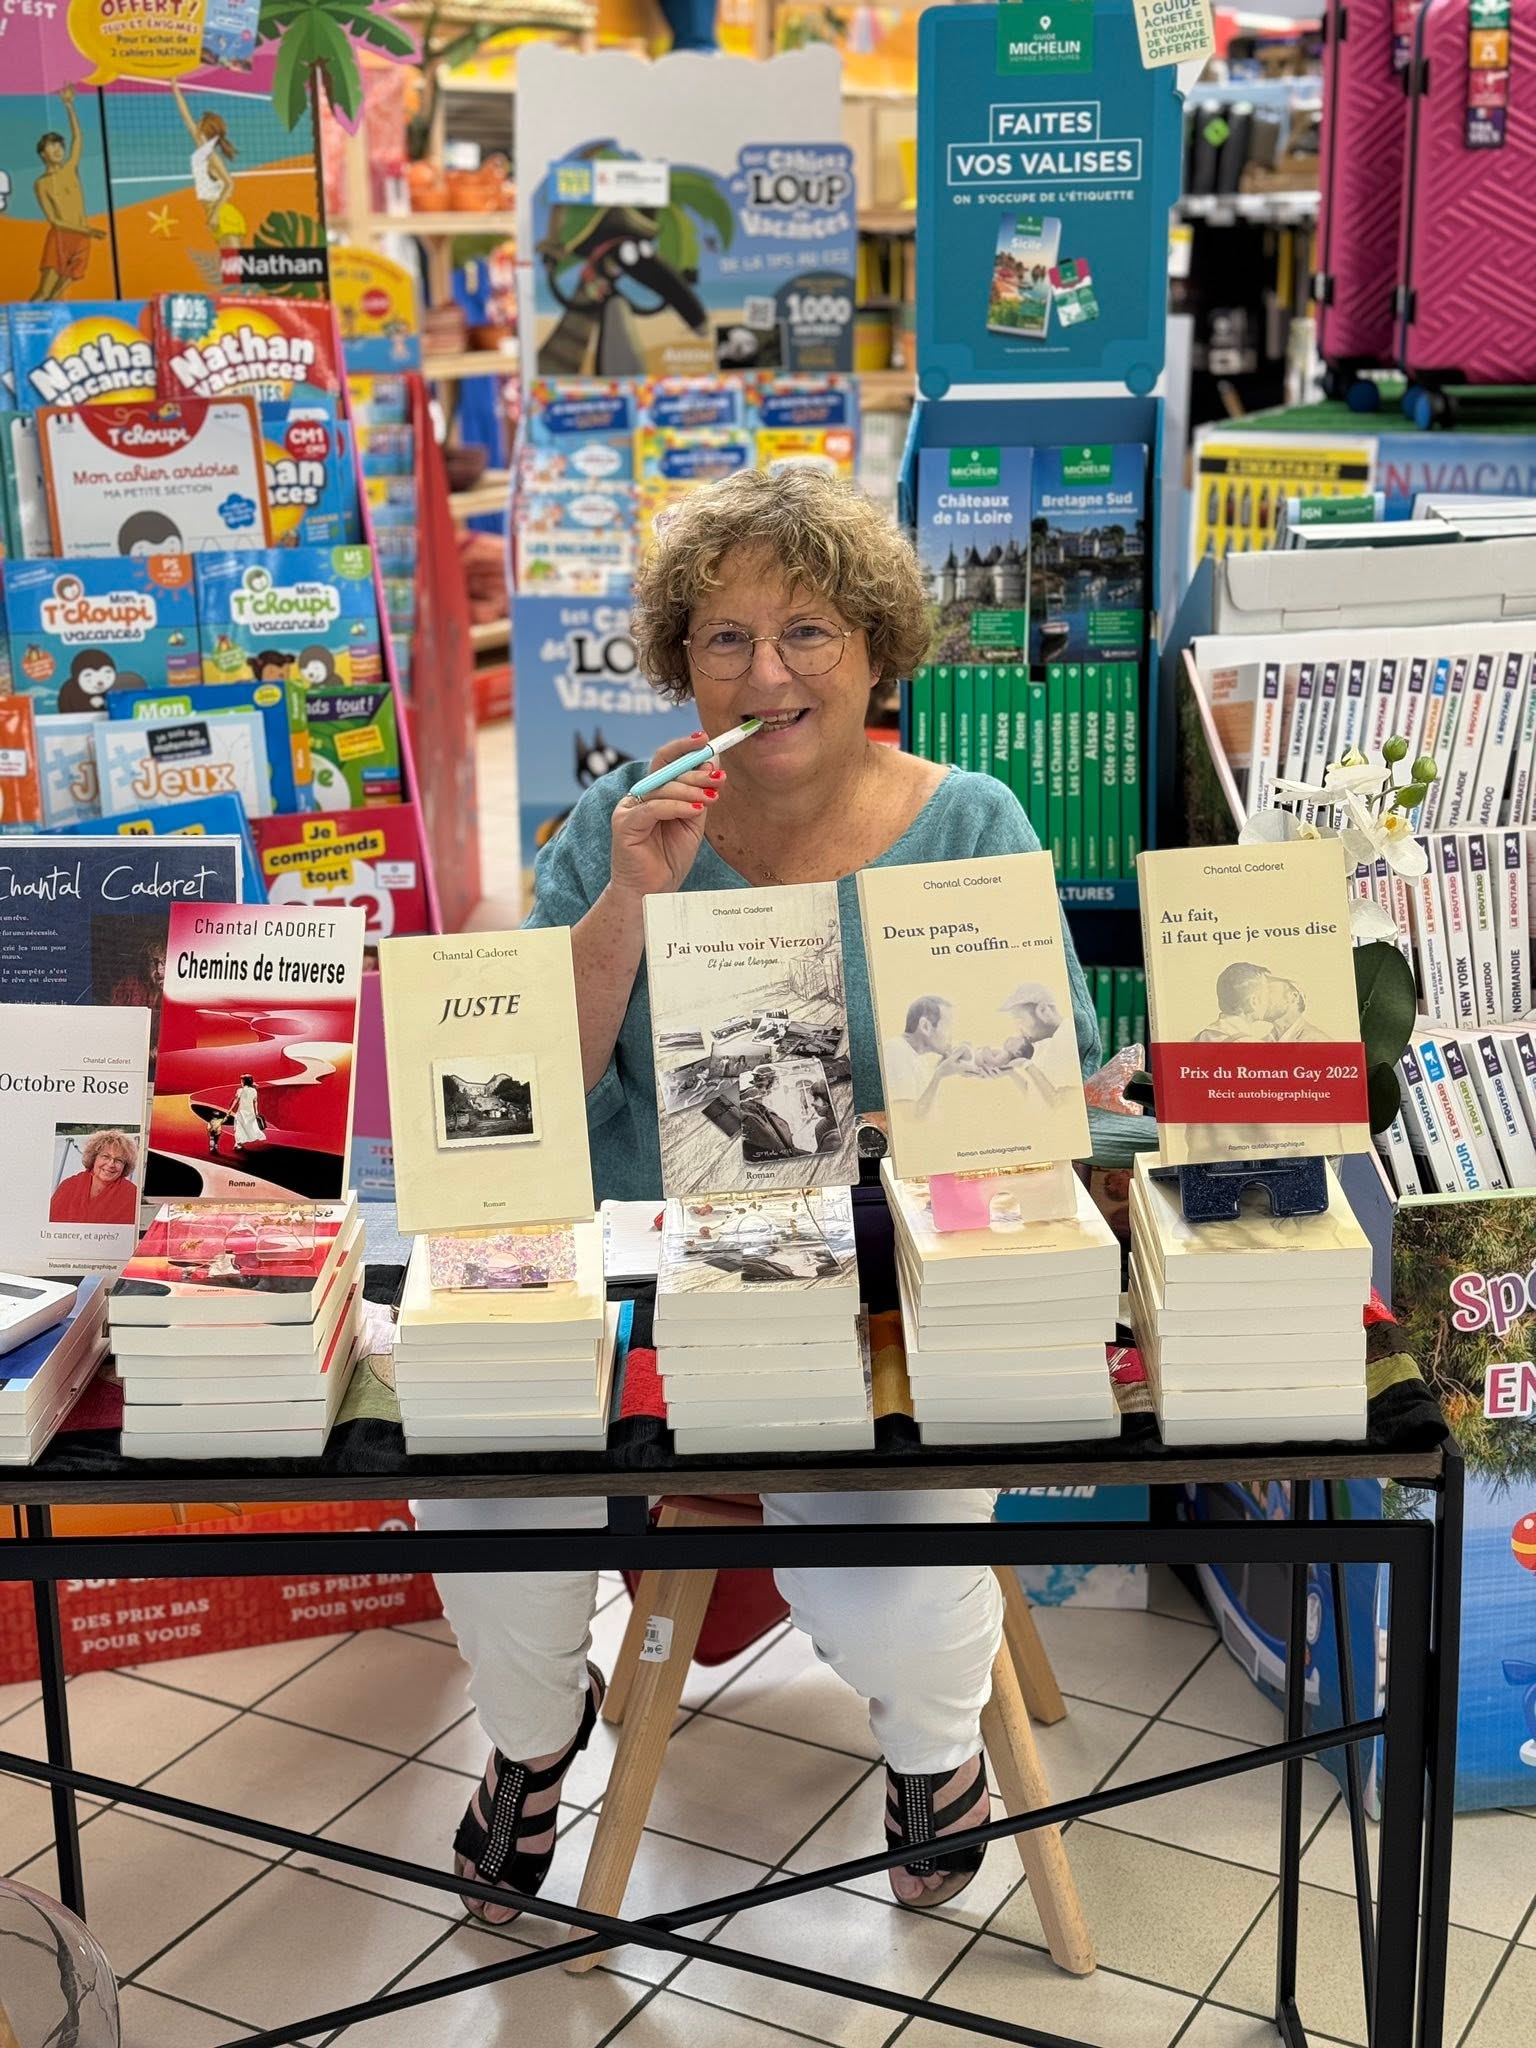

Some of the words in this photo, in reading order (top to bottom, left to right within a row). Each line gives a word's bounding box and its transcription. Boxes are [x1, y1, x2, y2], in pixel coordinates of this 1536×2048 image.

[101, 0, 186, 17] OFFERT
[1142, 6, 1148, 17] 1
[1153, 0, 1201, 14] GUIDE
[1145, 8, 1193, 29] ACHETÉ
[117, 35, 139, 44] Pour
[141, 34, 173, 44] l'achat
[176, 35, 188, 43] de
[1009, 40, 1081, 55] MICHELIN
[1147, 39, 1161, 48] DE
[1164, 28, 1206, 44] VOYAGE
[998, 111, 1093, 136] FAITES
[956, 153, 1012, 177] VOS
[1021, 150, 1132, 175] VALISES
[953, 194, 971, 205] ON
[978, 192, 1036, 204] S'OCCUPE
[1040, 192, 1055, 203] DE
[1058, 188, 1135, 202] L'ÉTIQUETTE
[1010, 237, 1043, 251] Sicile
[238, 253, 323, 276] Nathan
[169, 324, 315, 390] Nathan
[192, 361, 307, 398] vacances
[107, 423, 191, 450] T'choupi
[288, 427, 325, 445] CM1
[73, 471, 109, 485] Mon
[115, 464, 171, 483] cahier
[172, 463, 240, 479] ardoise
[951, 467, 998, 476] MICHELIN
[1063, 464, 1110, 475] MICHELIN
[103, 489, 121, 499] MA
[123, 486, 156, 498] PETITE
[159, 483, 213, 496] SECTION
[937, 493, 1009, 508] Châteaux
[1042, 493, 1104, 509] Bretagne
[1106, 491, 1133, 505] Sud
[933, 512, 954, 525] de
[956, 511, 970, 525] la
[973, 511, 1013, 525] Loire
[1301, 508, 1322, 519] IGN
[162, 559, 180, 570] PS
[344, 551, 363, 563] MS
[109, 591, 135, 604] Mon
[296, 584, 321, 596] Mon
[44, 600, 152, 626] T'choupi
[233, 591, 336, 616] T'choupi
[253, 617, 327, 632] vacances
[64, 627, 142, 643] vacances
[994, 711, 1008, 761] Alsace
[1013, 712, 1027, 749] Rome
[1084, 710, 1099, 761] Alsace
[1103, 710, 1117, 752] d'Azur
[1123, 710, 1136, 752] d'Azur
[1032, 719, 1043, 767] Réunion
[1051, 711, 1063, 774] Charentes
[1068, 711, 1080, 774] Charentes
[132, 758, 235, 799] Jeux
[1032, 768, 1044, 785] La
[1104, 755, 1117, 786] Côte
[1124, 755, 1136, 785] Côte
[1051, 777, 1063, 797] Les
[1068, 777, 1080, 796] Les
[1480, 786, 1495, 827] MAROC
[308, 825, 332, 840] Je
[269, 836, 379, 867] comprends
[305, 867, 349, 884] tout
[1203, 863, 1242, 875] Chantal
[1244, 861, 1285, 872] Cadoret
[101, 861, 218, 901] Cadoret
[923, 877, 961, 890] Chantal
[963, 875, 1002, 887] Cadoret
[1057, 886, 1115, 901] LTURES
[1449, 874, 1461, 922] ROUTARD
[1476, 873, 1486, 918] ROUTARD
[1508, 871, 1517, 916] ROUTARD
[712, 907, 741, 916] Chantal
[743, 905, 773, 914] Cadoret
[1160, 910, 1183, 924] Au
[1188, 907, 1219, 923] fait,
[194, 917, 258, 936] Chantal
[264, 920, 337, 939] CADORET
[883, 924, 925, 940] Deux
[929, 922, 979, 939] papas,
[1453, 922, 1461, 931] LE
[1479, 919, 1487, 929] LE
[1510, 917, 1517, 927] LE
[1162, 930, 1173, 944] il
[1177, 928, 1208, 944] faut
[1212, 930, 1241, 946] que
[1245, 926, 1260, 943] je
[1265, 924, 1300, 938] vous
[1305, 921, 1338, 936] dise
[433, 948, 473, 962] Chantal
[476, 947, 518, 959] Cadoret
[666, 942, 690, 958] J'ai
[695, 940, 734, 954] voulu
[738, 938, 765, 951] voir
[768, 935, 825, 950] Vierzon
[931, 944, 950, 956] un
[1022, 939, 1031, 948] et
[1034, 936, 1053, 947] moi
[177, 950, 248, 981] Chemins
[253, 953, 273, 981] de
[279, 955, 346, 984] traverse
[707, 957, 717, 969] Et
[718, 957, 732, 970] j'ai
[1456, 956, 1469, 987] YORK
[1510, 948, 1522, 1013] NORMANDIE
[438, 994, 521, 1026] JUSTE
[1459, 988, 1472, 1017] NEW
[83, 1056, 106, 1064] Chantal
[107, 1057, 131, 1065] Cadoret
[0, 1073, 76, 1094] Octobre
[82, 1076, 129, 1095] Rose
[1179, 1066, 1209, 1080] Prix
[1213, 1066, 1232, 1079] du
[1236, 1066, 1288, 1080] Roman
[1293, 1066, 1321, 1083] Gay
[1325, 1066, 1359, 1079] 2022
[1208, 1088, 1235, 1099] Récit
[1238, 1089, 1331, 1102] autobiographique
[1459, 1079, 1479, 1125] ROUTARD
[1494, 1077, 1515, 1124] ROUTARD
[1473, 1126, 1483, 1137] LE
[1507, 1124, 1517, 1135] LE
[957, 1150, 978, 1158] Roman
[979, 1143, 1032, 1157] autobiographique
[1250, 1140, 1305, 1151] autobiographique
[746, 1171, 775, 1180] Roman
[1454, 1142, 1480, 1190] D'AZUR
[228, 1179, 256, 1188] Roman
[483, 1200, 506, 1208] Roman
[40, 1230, 52, 1240] Un
[54, 1231, 82, 1242] cancer,
[84, 1231, 94, 1240] et
[95, 1231, 120, 1243] après?
[72, 1263, 117, 1271] autobiographique
[282, 1581, 320, 1600] DES
[324, 1575, 368, 1594] PRIX
[71, 1613, 112, 1632] DES
[117, 1606, 165, 1625] PRIX
[170, 1598, 210, 1617] BAS
[291, 1603, 347, 1622] POUR
[353, 1592, 406, 1613] VOUS
[81, 1635, 141, 1654] POUR
[145, 1622, 202, 1644] VOUS
